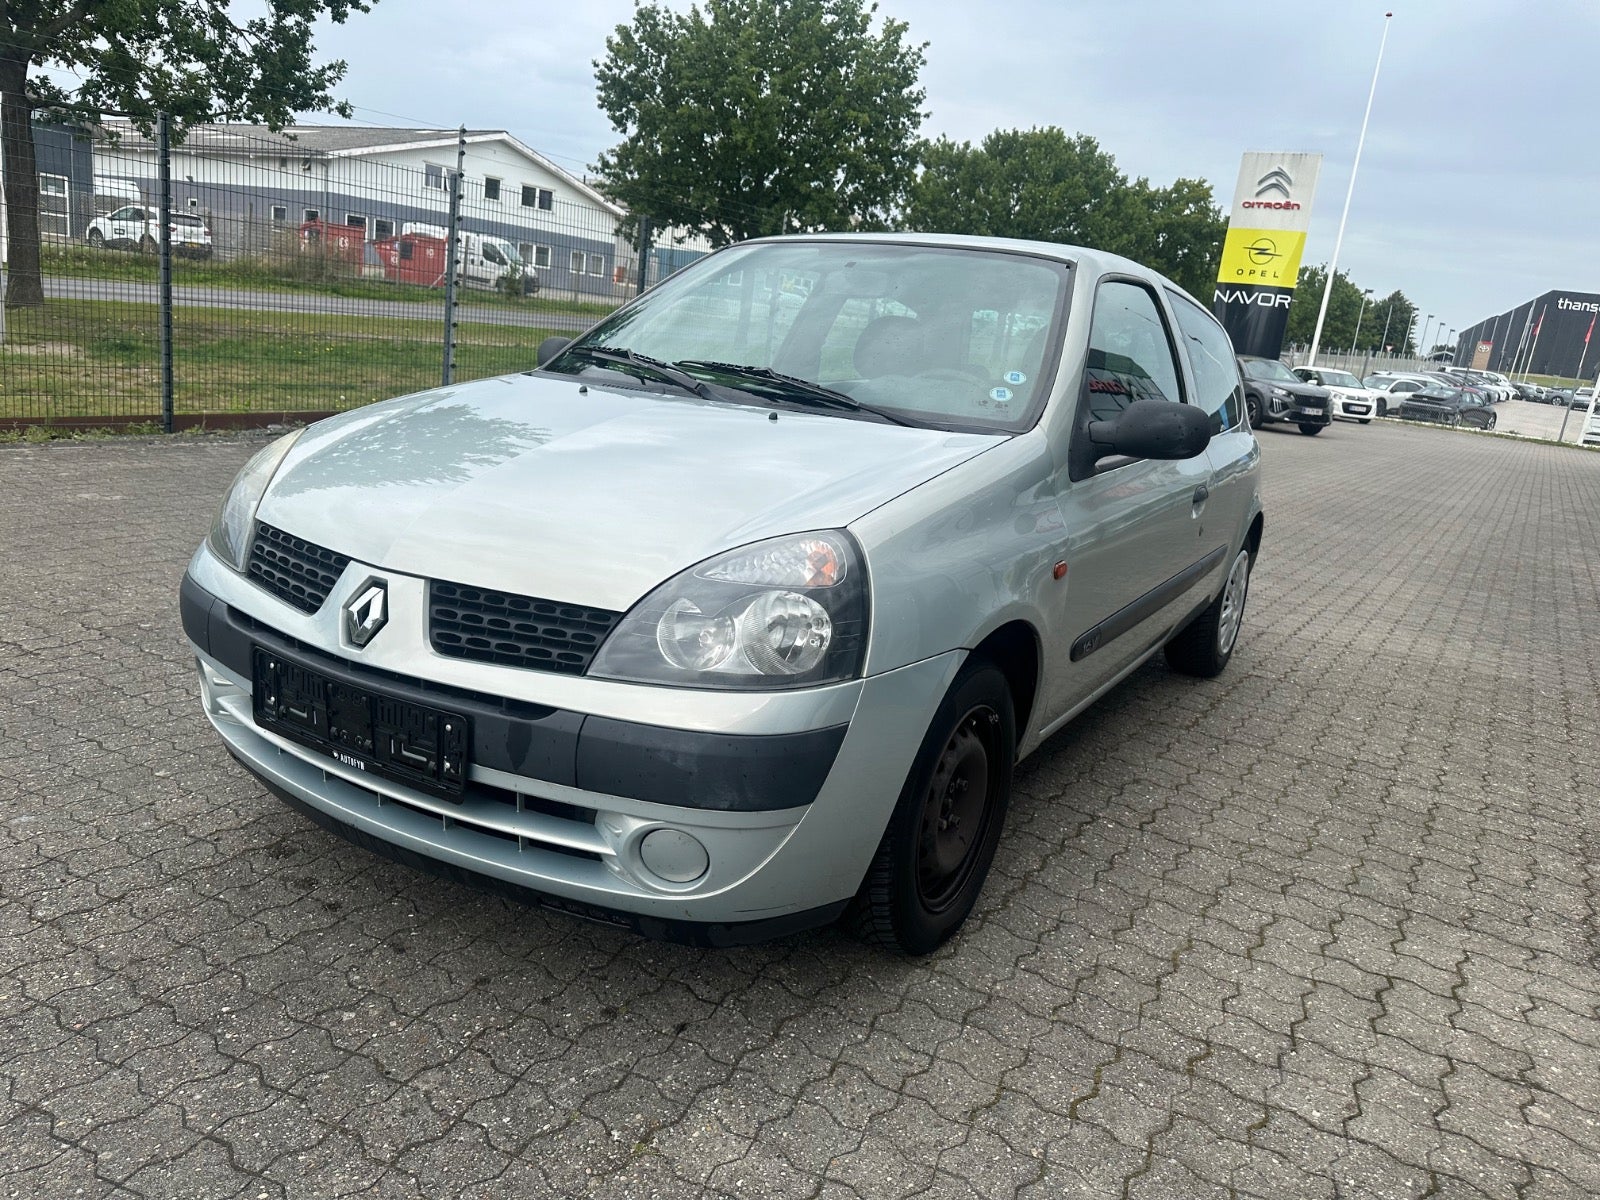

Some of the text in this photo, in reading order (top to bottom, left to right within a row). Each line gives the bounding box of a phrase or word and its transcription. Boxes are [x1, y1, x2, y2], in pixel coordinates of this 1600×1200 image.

[1236, 268, 1279, 278] OPEL
[1213, 290, 1291, 308] NAVOR
[1558, 298, 1600, 312] thans
